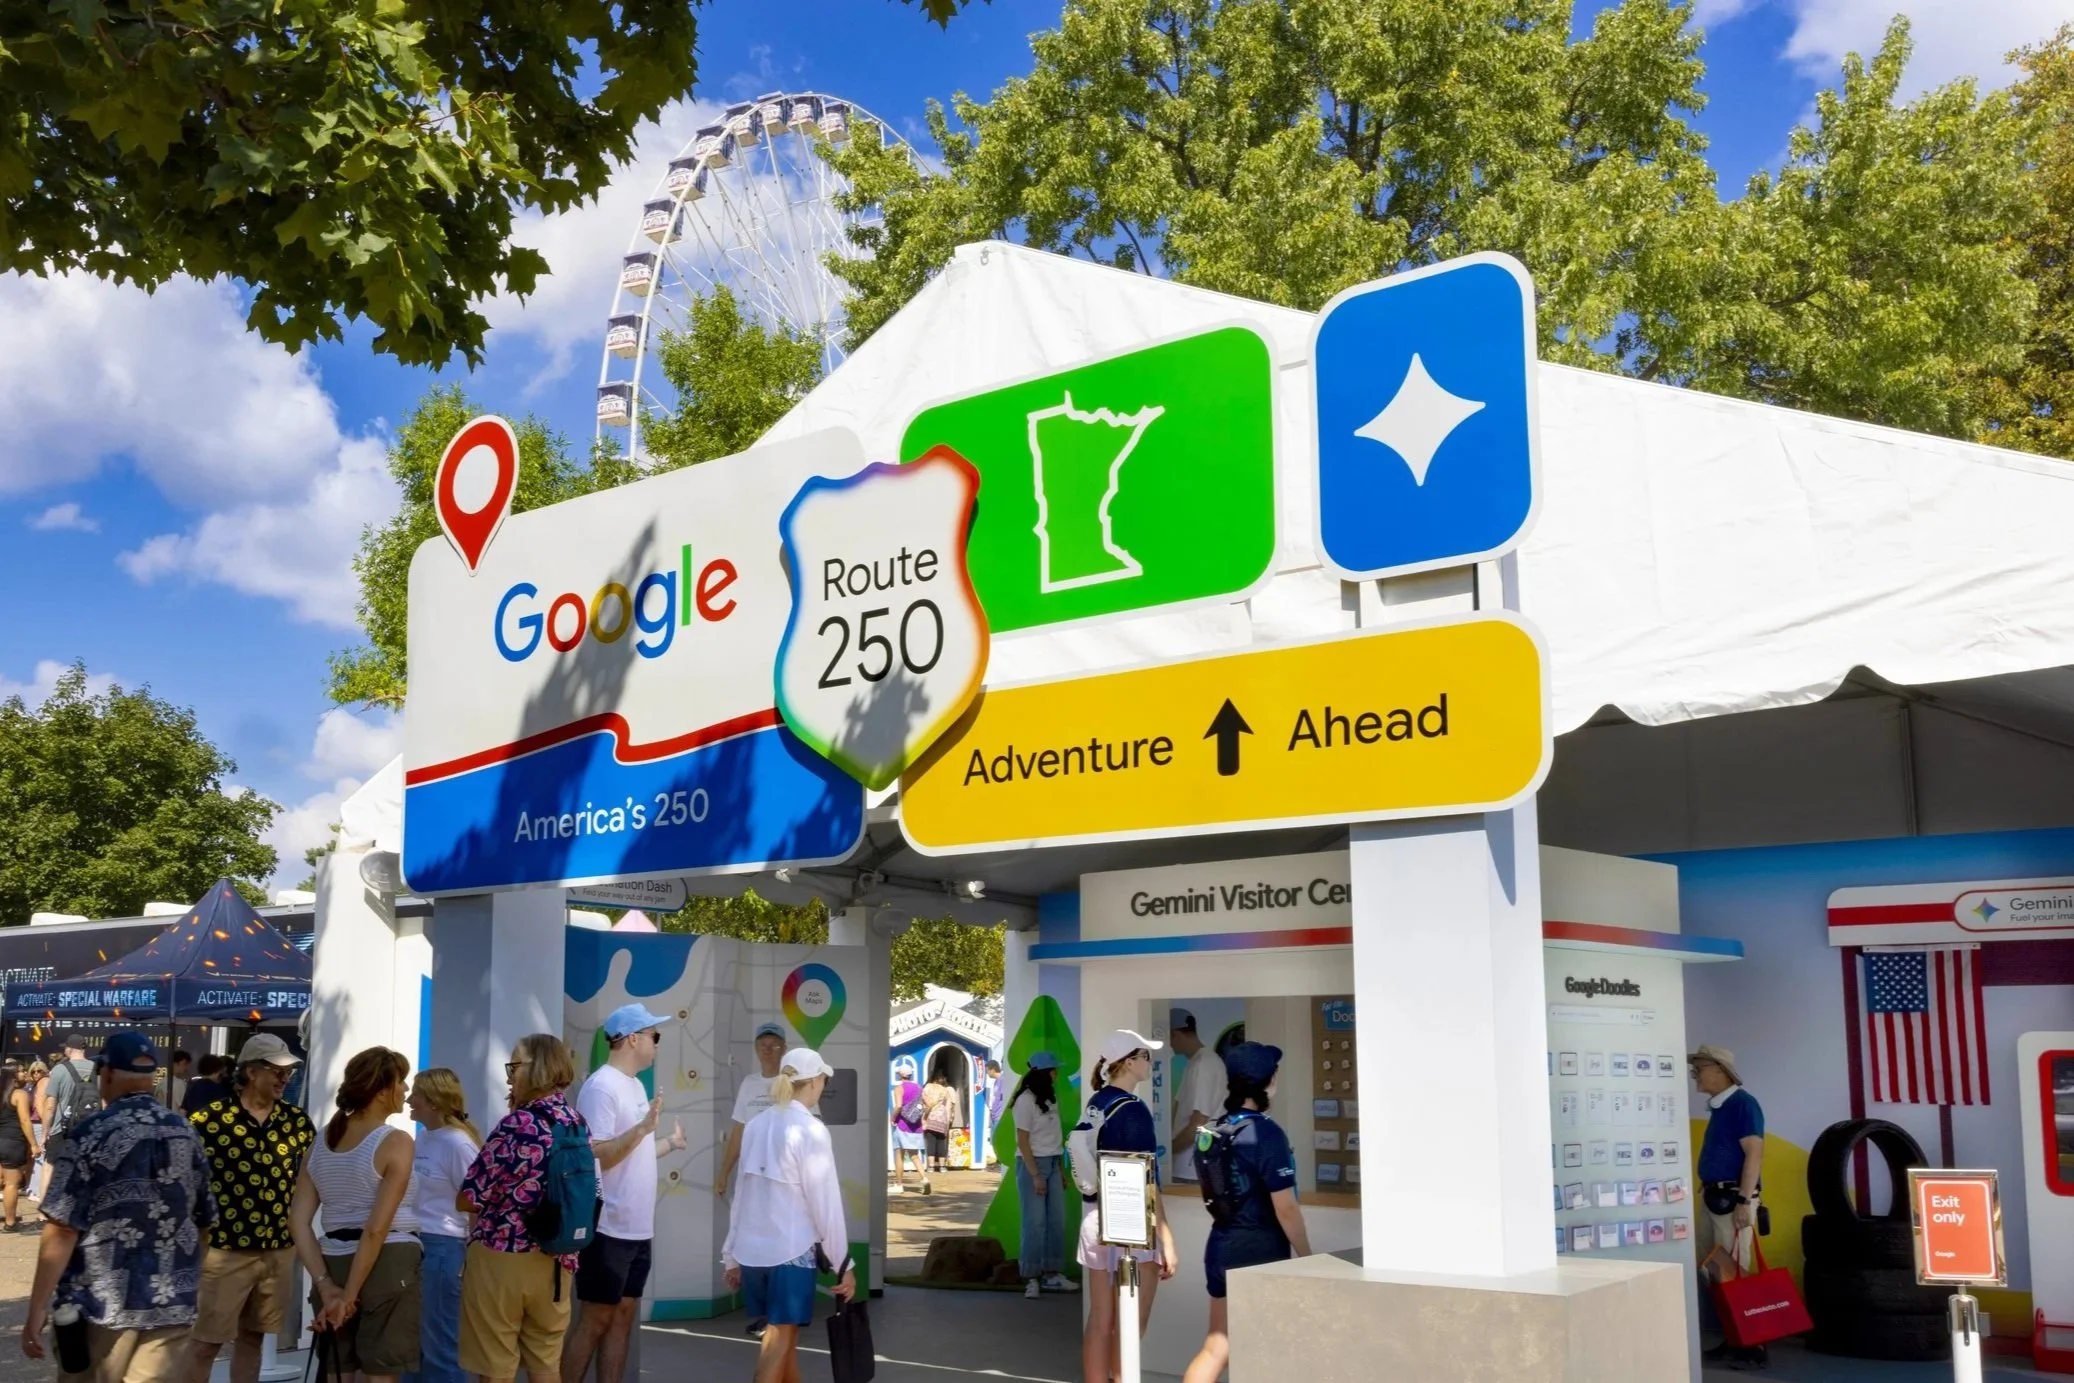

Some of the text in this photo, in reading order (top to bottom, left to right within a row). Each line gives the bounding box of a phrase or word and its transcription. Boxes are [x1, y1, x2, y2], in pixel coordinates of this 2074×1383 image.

[823, 546, 938, 602] Route
[494, 544, 739, 662] Google
[817, 598, 945, 690] 250
[963, 693, 1448, 787] Adventure Ahead
[653, 788, 710, 827] 250
[646, 879, 673, 893] Dash
[1131, 886, 1216, 917] Gemini
[1219, 881, 1303, 912] Visitor
[2009, 895, 2073, 911] Gemini
[2010, 913, 2031, 922] Fuel
[2031, 912, 2055, 923] your
[1564, 976, 1641, 998] Google Doodles
[58, 990, 101, 1007] SPECIAL
[103, 989, 157, 1006] WARFARE
[197, 990, 312, 1008] ACTIVATE: SPECI
[1931, 1195, 1961, 1208] Exit
[1932, 1211, 1966, 1227] only
